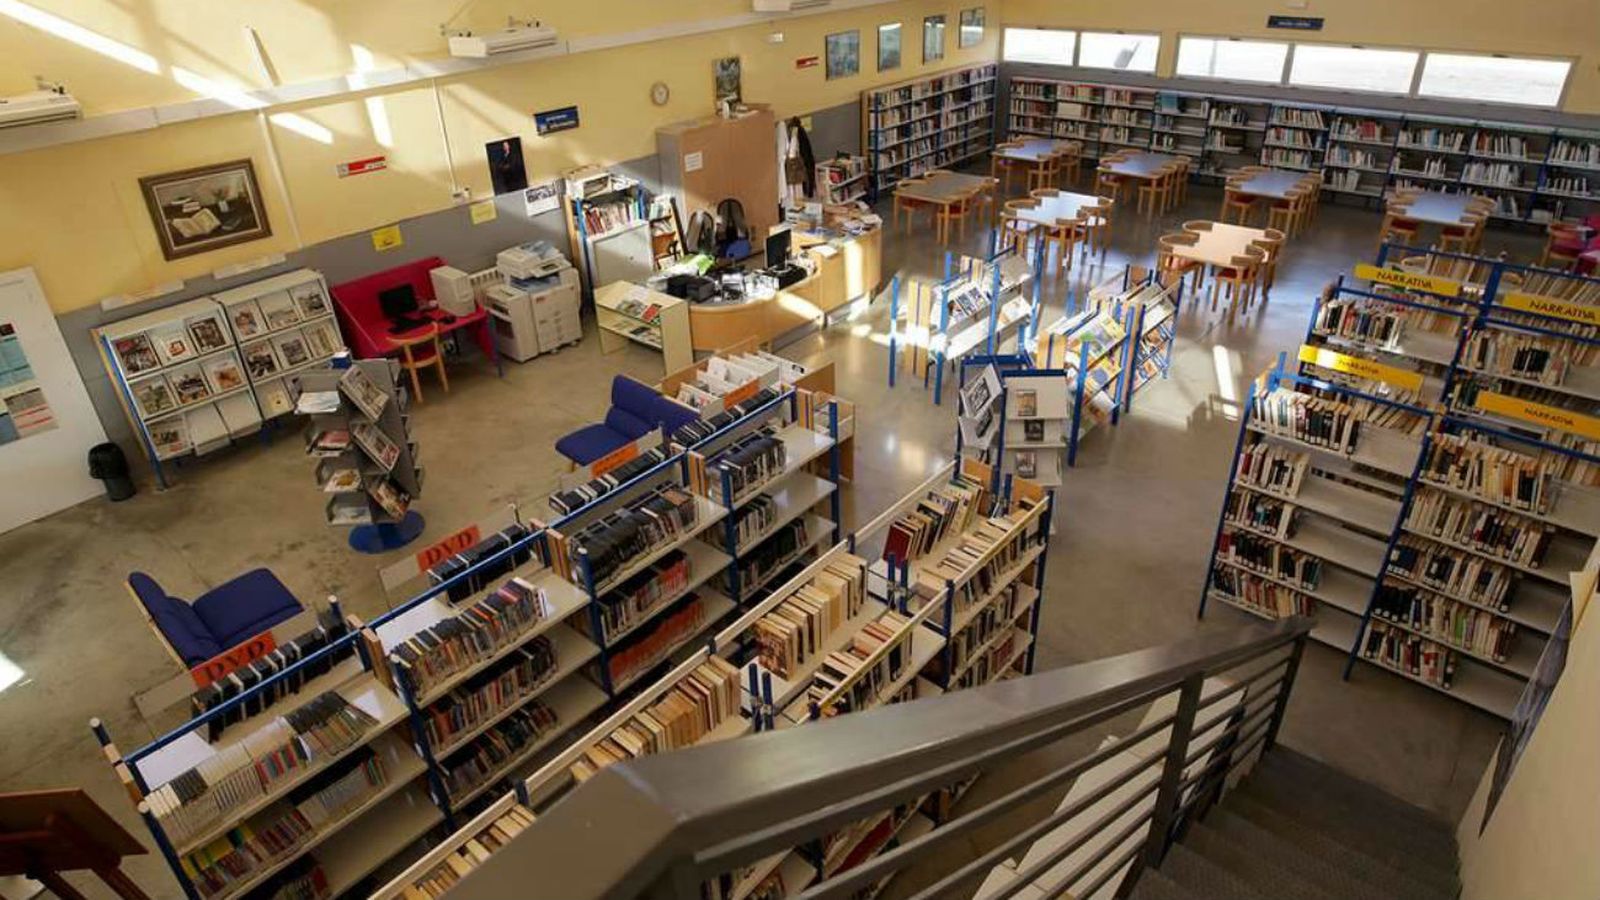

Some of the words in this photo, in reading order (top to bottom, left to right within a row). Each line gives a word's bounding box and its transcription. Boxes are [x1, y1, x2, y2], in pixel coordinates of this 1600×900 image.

[1375, 270, 1433, 290] NARRATIVA
[1529, 300, 1596, 320] NARRATIVA
[1524, 407, 1575, 427] NARRATIVA
[425, 530, 473, 565] DVD
[205, 640, 265, 681] DVD
